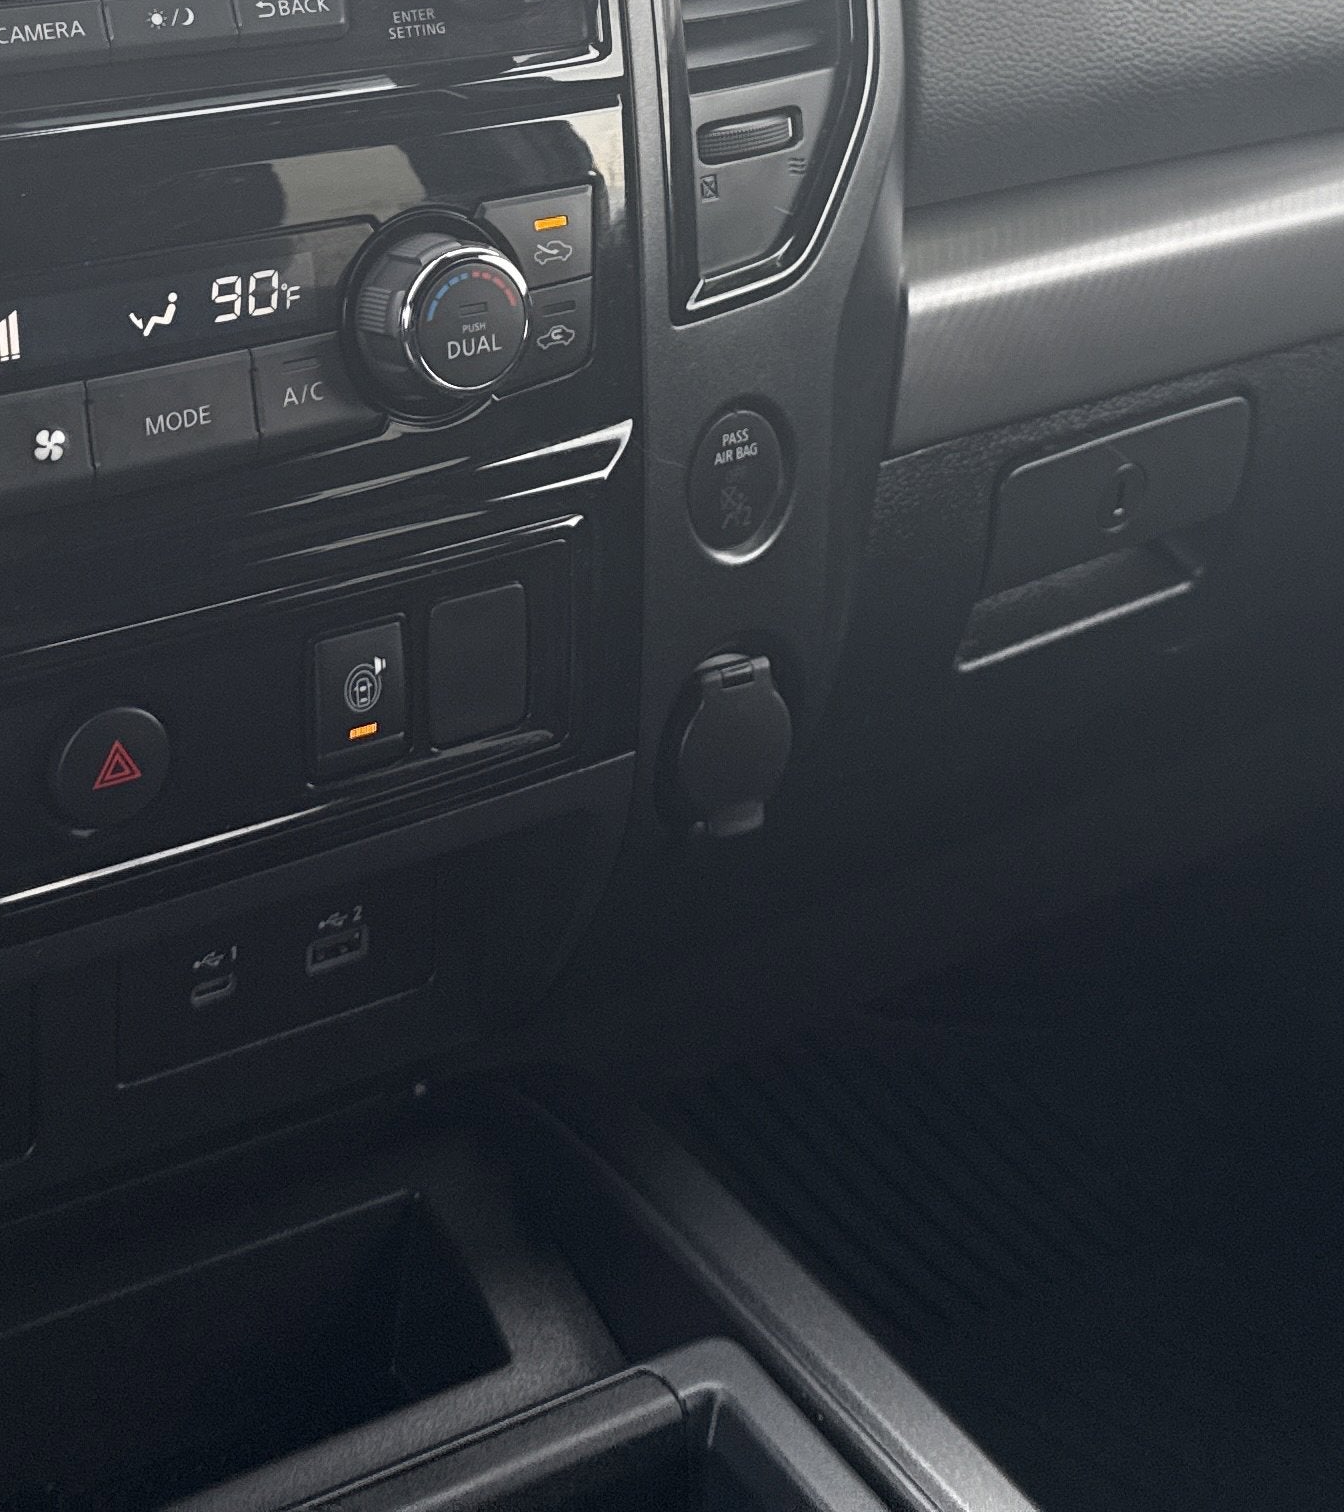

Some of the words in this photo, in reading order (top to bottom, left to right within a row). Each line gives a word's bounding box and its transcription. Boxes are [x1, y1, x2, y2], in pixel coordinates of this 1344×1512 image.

[392, 7, 436, 23] ENTER
[388, 21, 446, 40] SETTING
[462, 321, 487, 334] PUSH
[446, 334, 503, 361] DUAL
[282, 381, 325, 408] A/C
[144, 405, 213, 437] MODE
[722, 428, 749, 446] PASS
[714, 449, 734, 465] AIR
[736, 443, 758, 460] BAG
